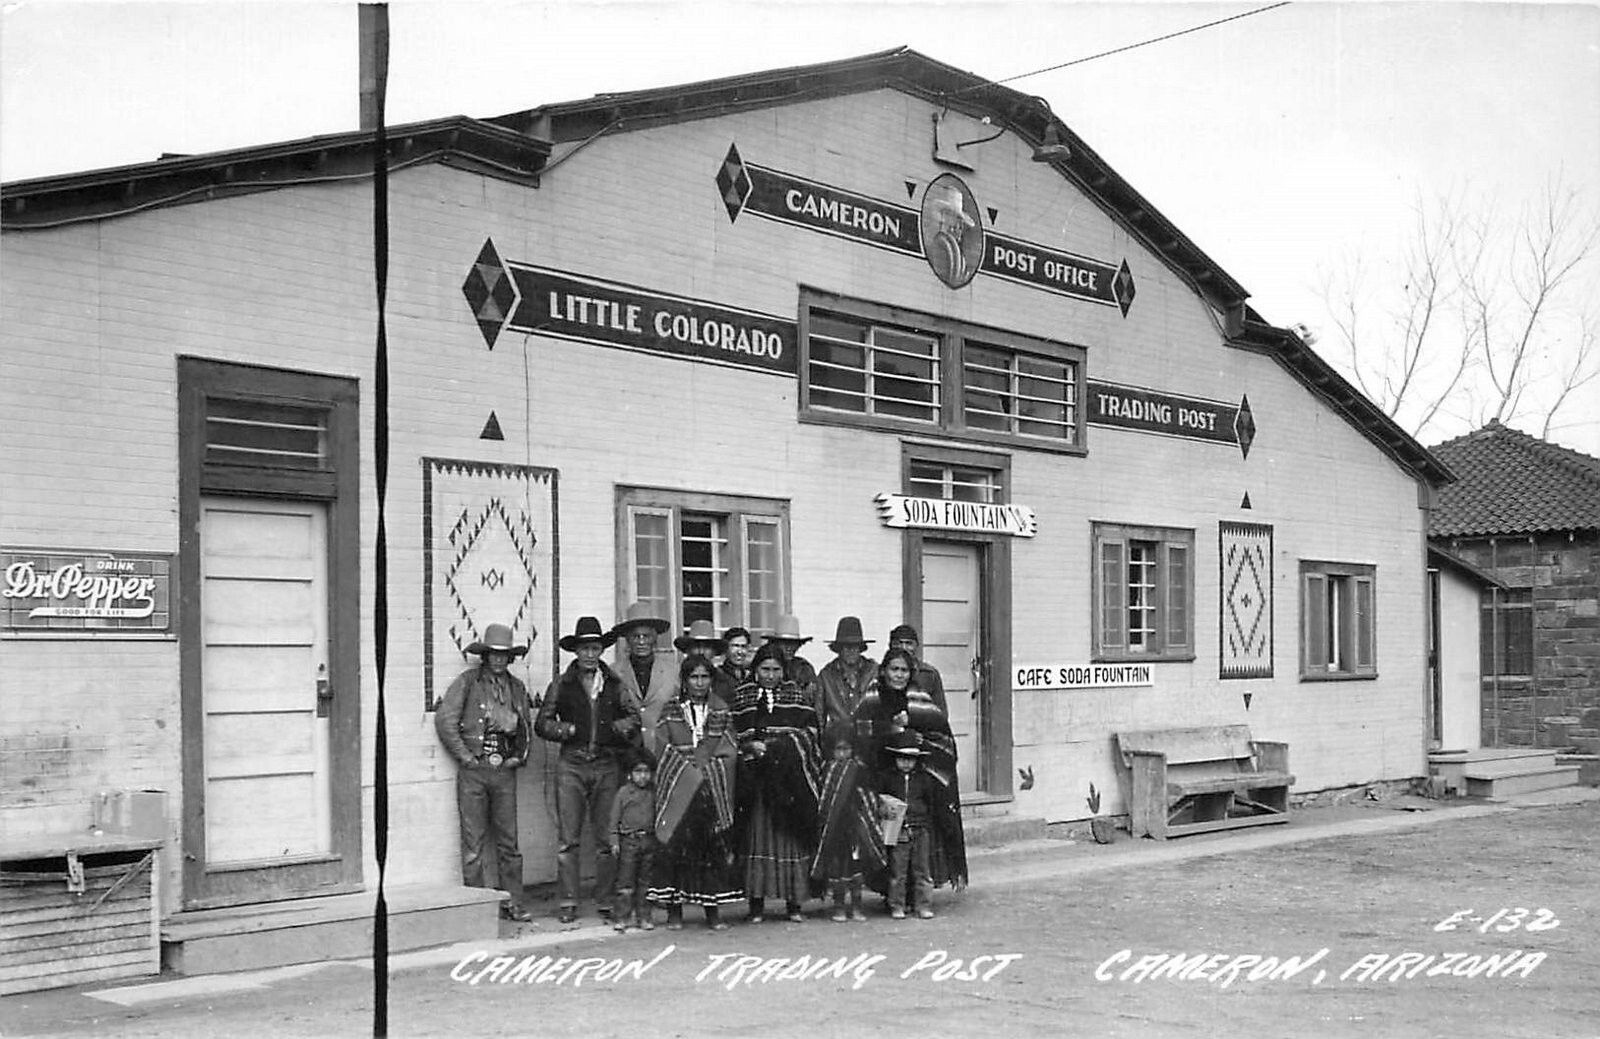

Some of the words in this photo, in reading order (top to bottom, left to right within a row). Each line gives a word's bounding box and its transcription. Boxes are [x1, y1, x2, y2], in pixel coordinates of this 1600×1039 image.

[786, 189, 900, 239] CAMERON
[994, 246, 1037, 275] POST
[1044, 260, 1099, 292] OFFICE
[550, 291, 643, 334] LITTLE
[654, 311, 783, 360] COLORADO
[1098, 394, 1172, 425] TRADING
[1178, 407, 1217, 431] POST
[903, 499, 938, 525] SODA
[945, 502, 1008, 529] FOUNTAIN
[97, 561, 135, 570] DRINK
[1017, 669, 1052, 686] CAFE
[1060, 667, 1091, 684] SODA
[1094, 666, 1150, 683] FOUNTAIN
